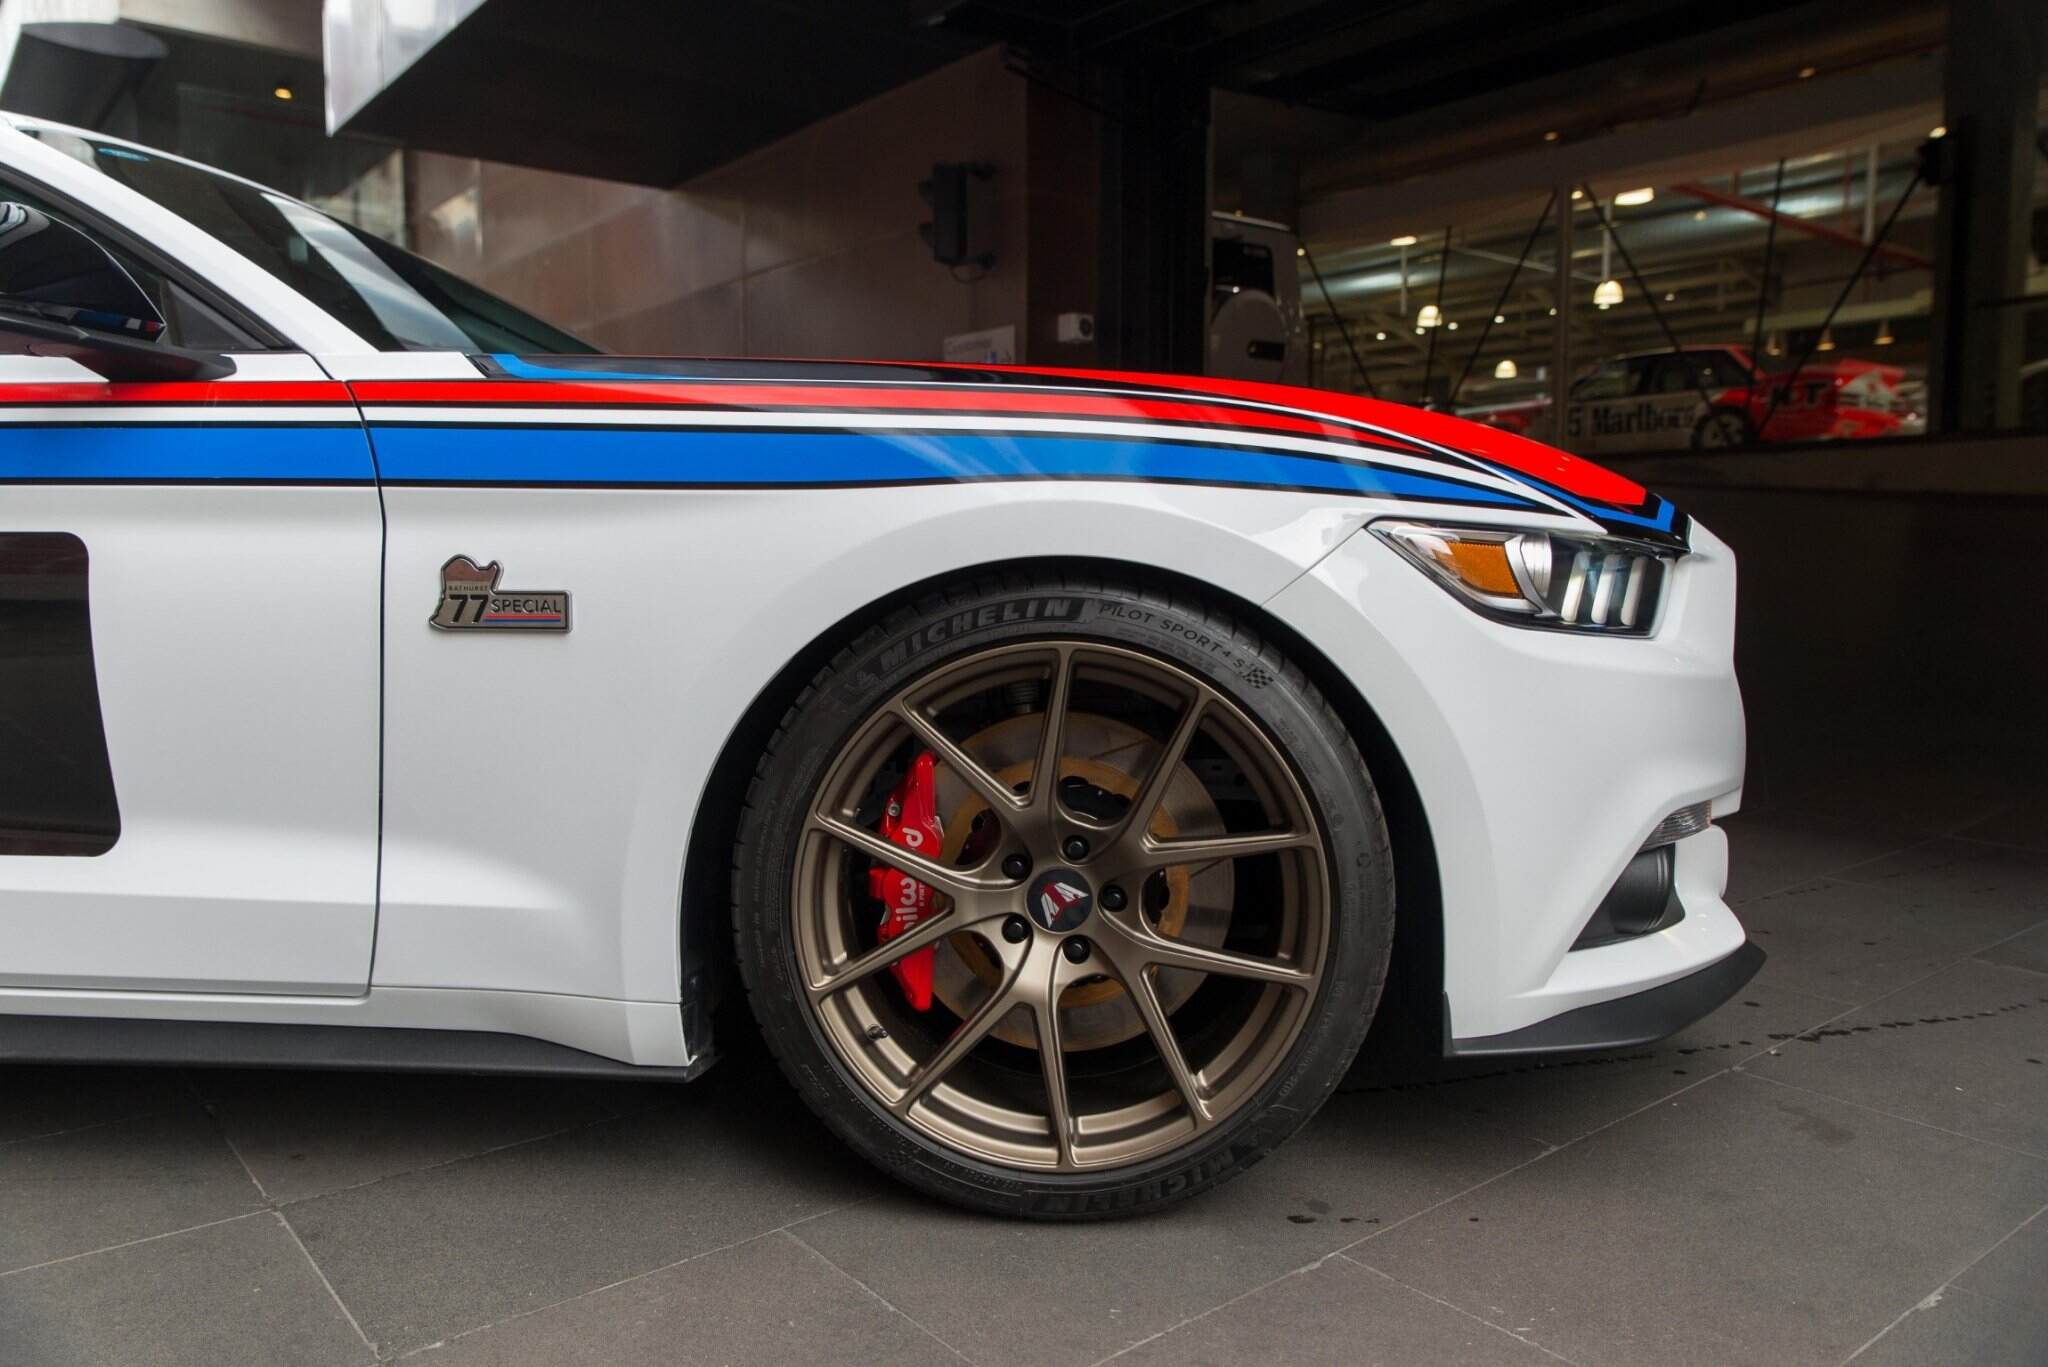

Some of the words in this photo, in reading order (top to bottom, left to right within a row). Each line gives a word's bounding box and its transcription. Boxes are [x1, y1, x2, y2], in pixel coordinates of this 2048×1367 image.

[449, 584, 489, 592] BATHURST
[449, 594, 489, 623] 77
[491, 599, 562, 614] SPECIAL
[880, 598, 1071, 669] MICHELIN
[1100, 603, 1154, 625] PILOT
[1160, 619, 1222, 653] SPORT
[1233, 659, 1246, 669] S
